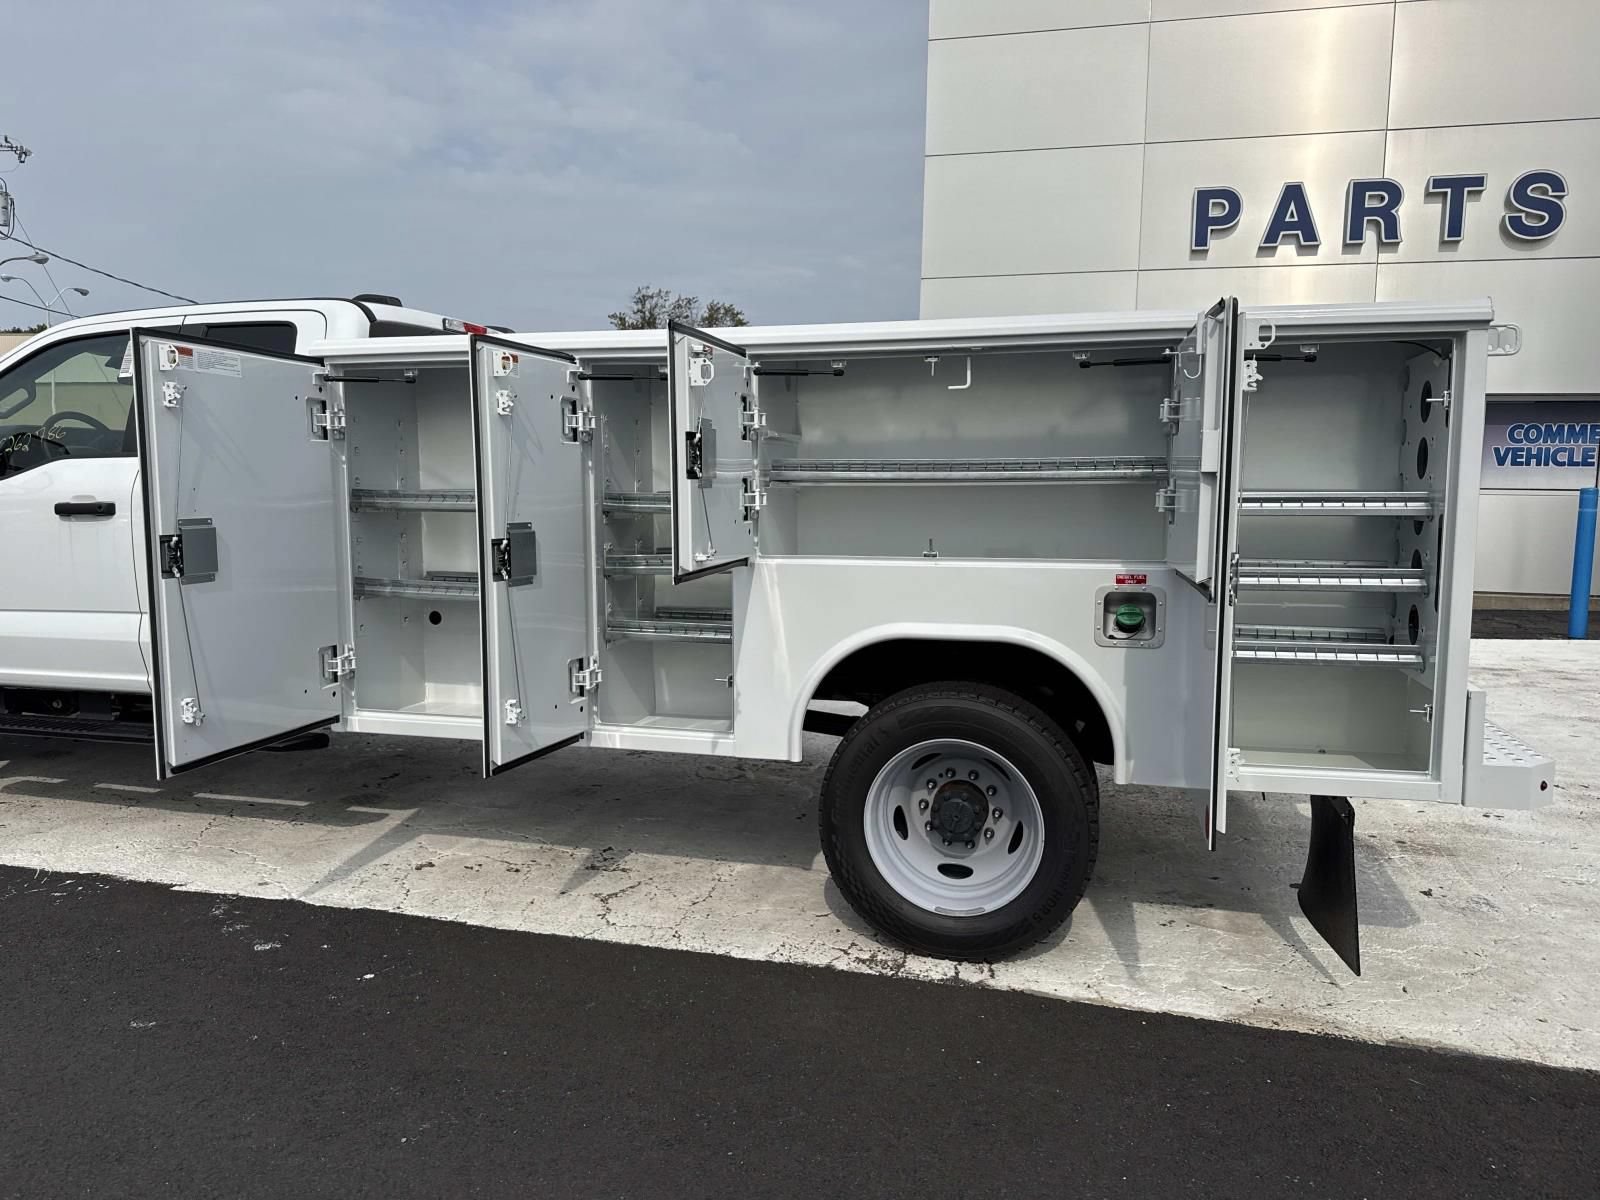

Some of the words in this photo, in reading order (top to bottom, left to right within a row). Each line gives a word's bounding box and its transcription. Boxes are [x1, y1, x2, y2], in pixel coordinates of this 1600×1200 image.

[1191, 169, 1569, 251] PARTS
[1507, 423, 1600, 445] COMME
[1492, 446, 1597, 468] VEHICLE
